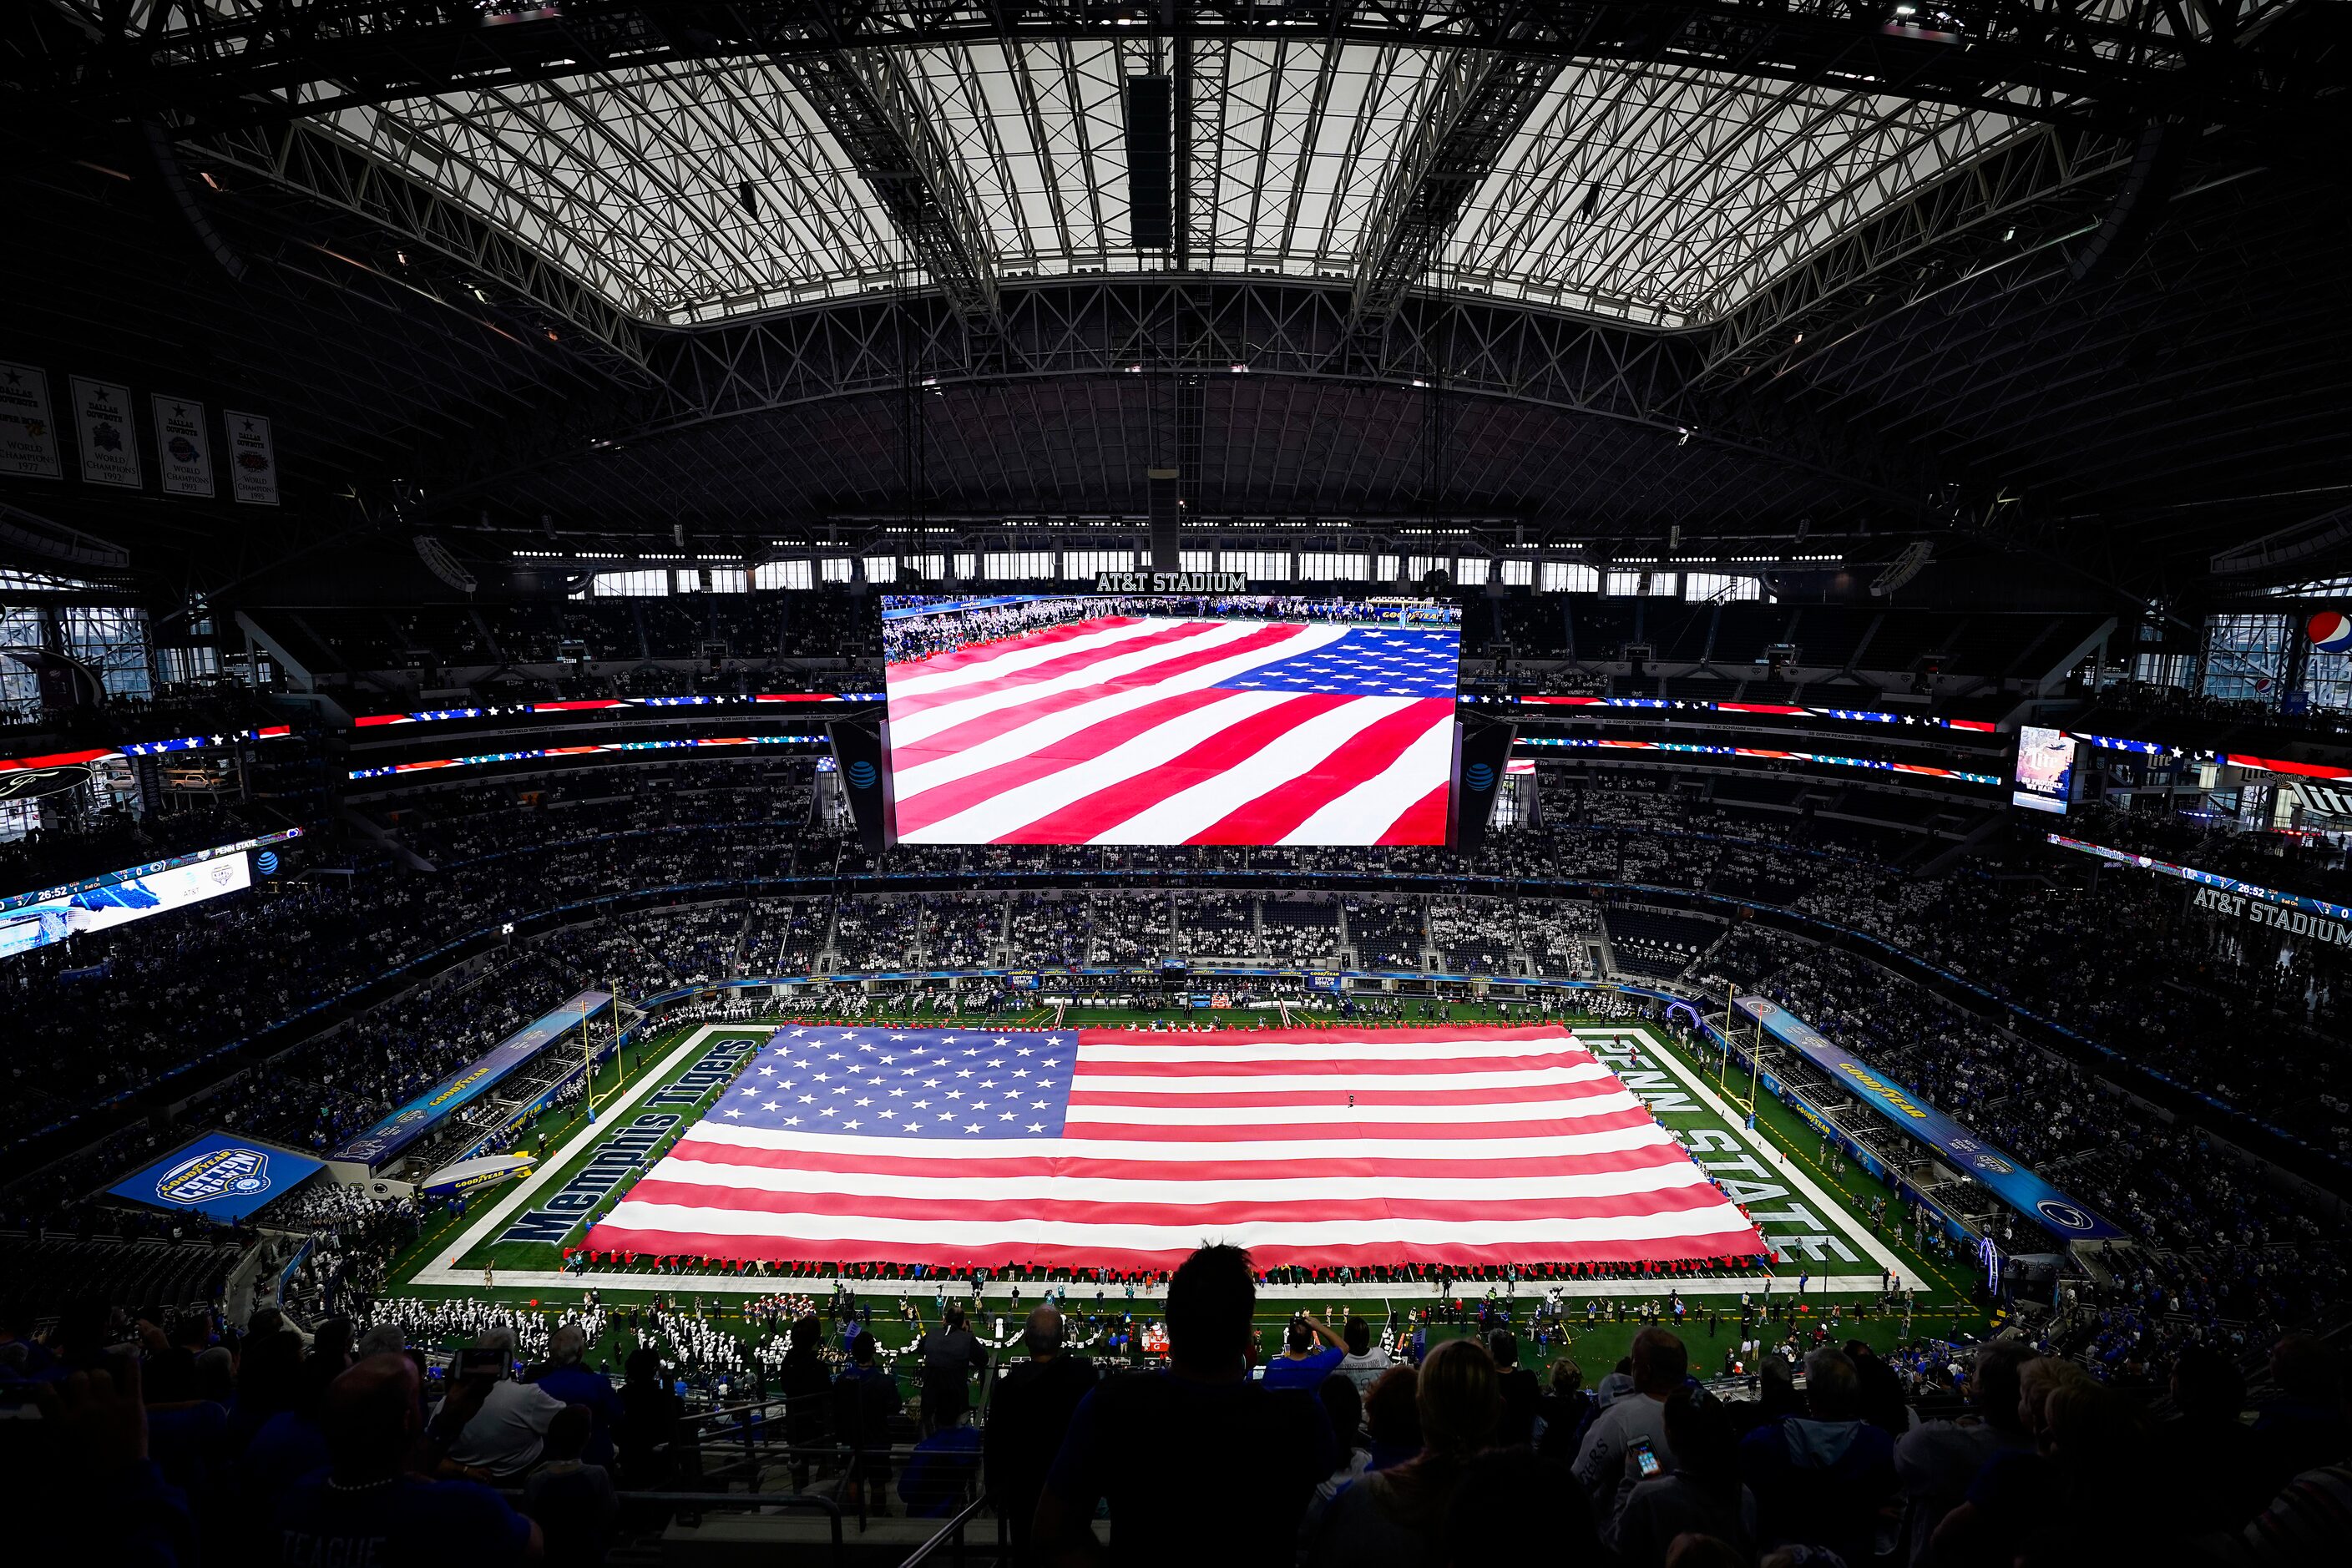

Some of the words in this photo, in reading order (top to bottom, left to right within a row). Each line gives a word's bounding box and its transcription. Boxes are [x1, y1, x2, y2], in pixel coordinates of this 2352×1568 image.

[89, 402, 119, 413] DALLAS
[86, 410, 123, 422] COWBOYS
[168, 418, 194, 428] DALLAS
[167, 426, 198, 436] COWBOYS
[8, 440, 43, 453] WORLD
[94, 453, 126, 463] WORLD
[18, 462, 38, 472] 1977
[86, 460, 136, 474] CHAMPIONS
[174, 464, 200, 475] WORLD
[104, 473, 122, 482] 1992
[167, 473, 209, 485] CHAMPIONS
[244, 475, 267, 485] WORLD
[181, 483, 197, 491] 1993
[238, 483, 275, 493] CHAMPIONS
[1096, 573, 1148, 591] AT&T
[1154, 573, 1247, 591] STADIUM
[2147, 753, 2172, 770] Lite
[215, 844, 235, 856] PENN
[235, 839, 258, 851] STATE
[2097, 846, 2125, 860] Memphis
[136, 867, 143, 877] 0
[2205, 874, 2212, 884] 0
[38, 886, 68, 902] 26:52
[183, 887, 200, 898] AT&T
[2238, 883, 2265, 898] 26:52
[2193, 888, 2246, 917] AT&T
[2250, 901, 2352, 949] STADIUM
[2341, 909, 2349, 918] 0
[642, 1039, 756, 1107] Tigers
[1585, 1039, 1703, 1112] PENN
[429, 1068, 491, 1106] GOODYEAR
[1839, 1063, 1927, 1119] GOODYEAR
[1796, 1103, 1831, 1135] GOODYEAR
[161, 1151, 232, 1191] GOODYEAR
[171, 1153, 256, 1198] COTTON
[200, 1166, 253, 1194] BOWL
[455, 1171, 504, 1188] GOODYEAR
[488, 1113, 681, 1247] Memphis
[1672, 1129, 1862, 1263] STATE
